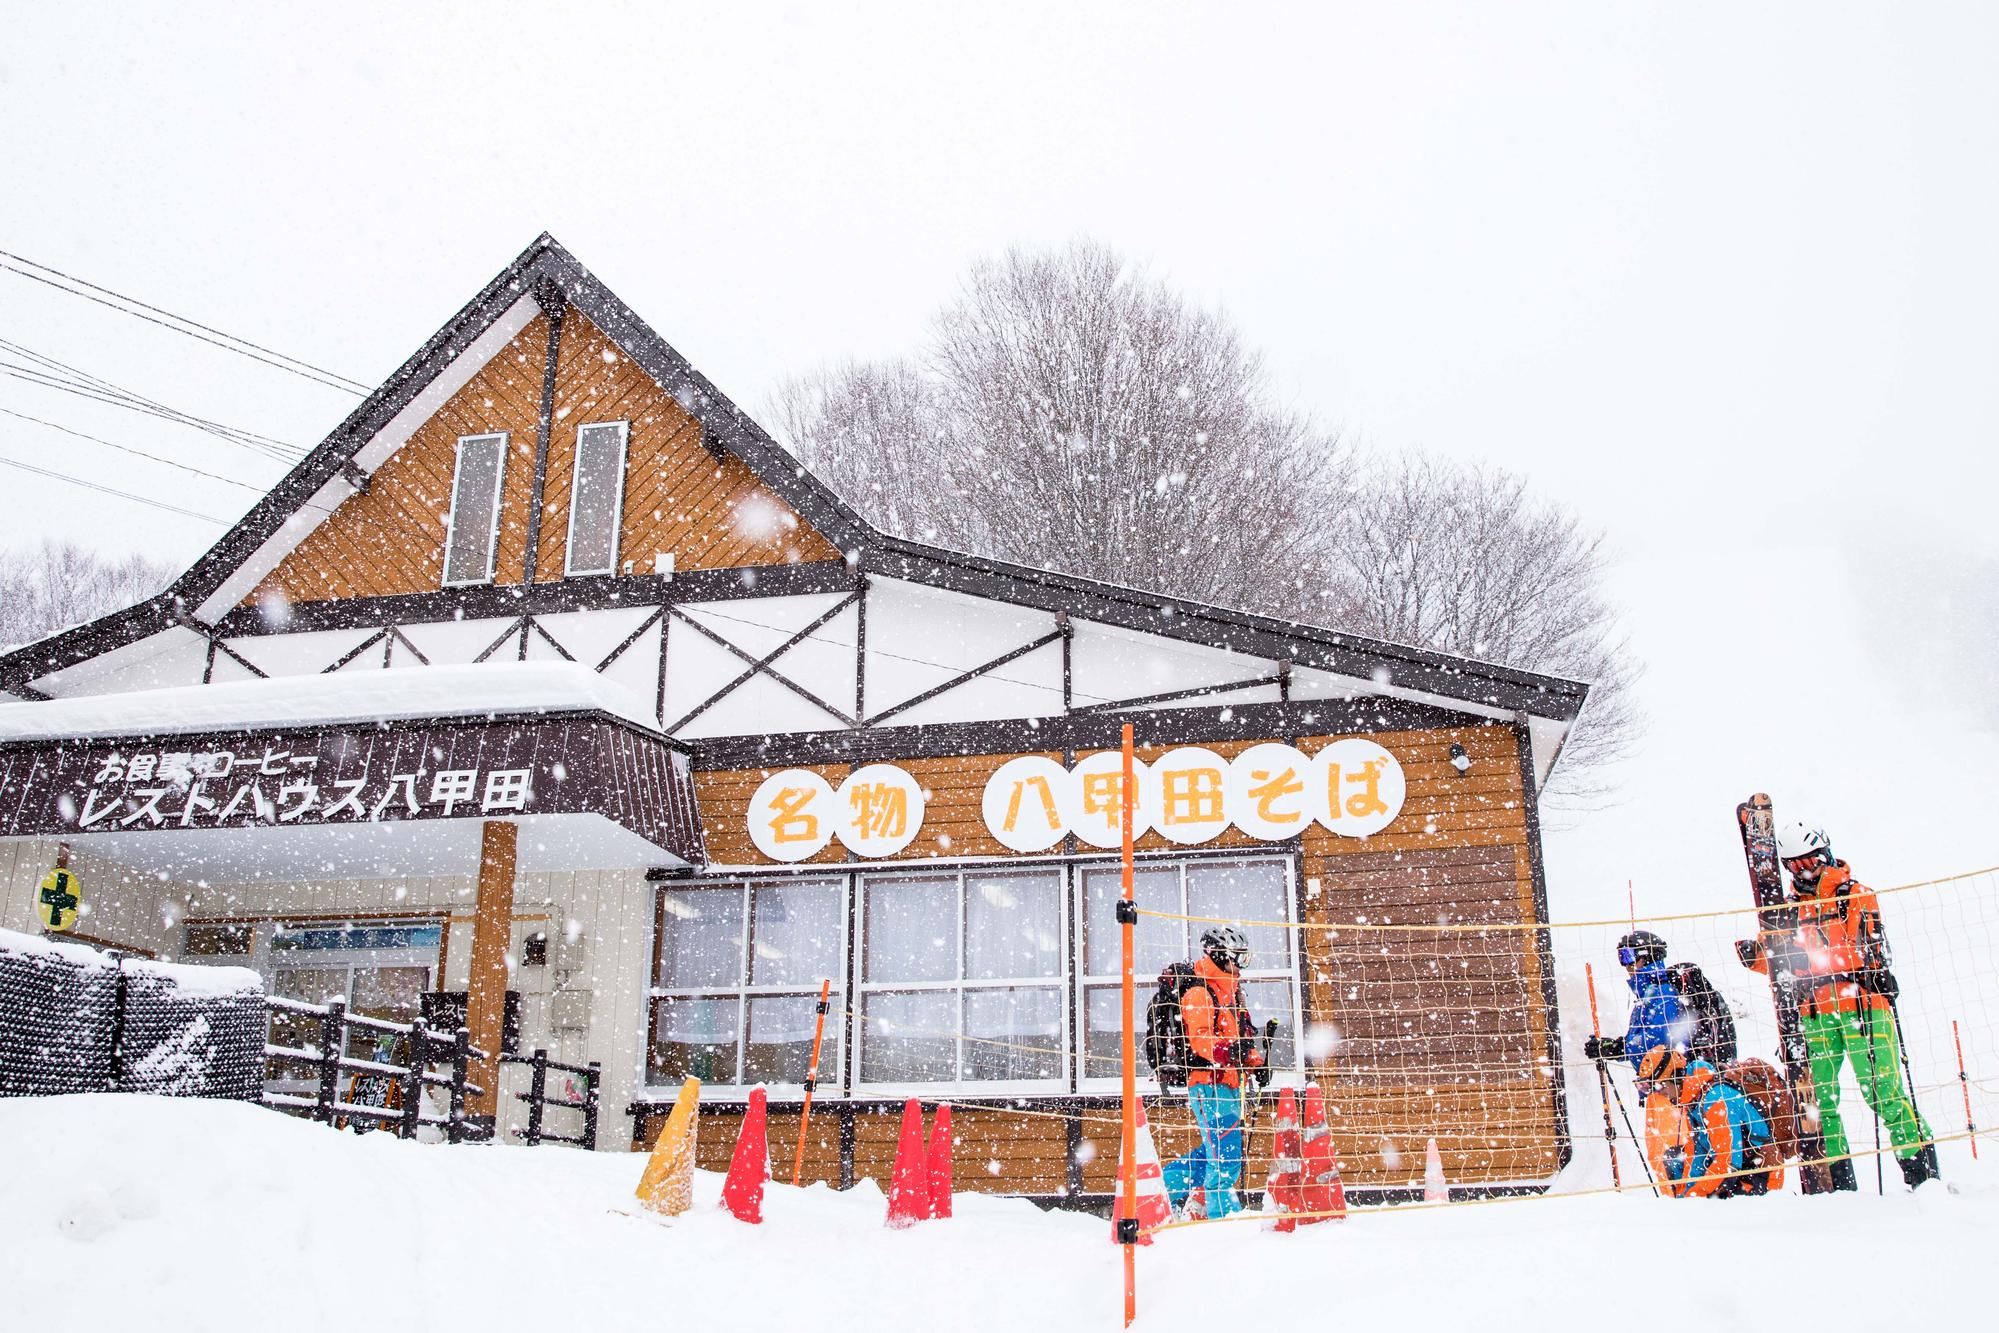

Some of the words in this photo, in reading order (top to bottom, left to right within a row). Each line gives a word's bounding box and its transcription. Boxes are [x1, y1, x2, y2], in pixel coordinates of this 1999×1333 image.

[78, 768, 531, 829] レストハウス八甲田
[767, 782, 907, 844] 名物
[1002, 755, 1389, 832] 八甲田そば
